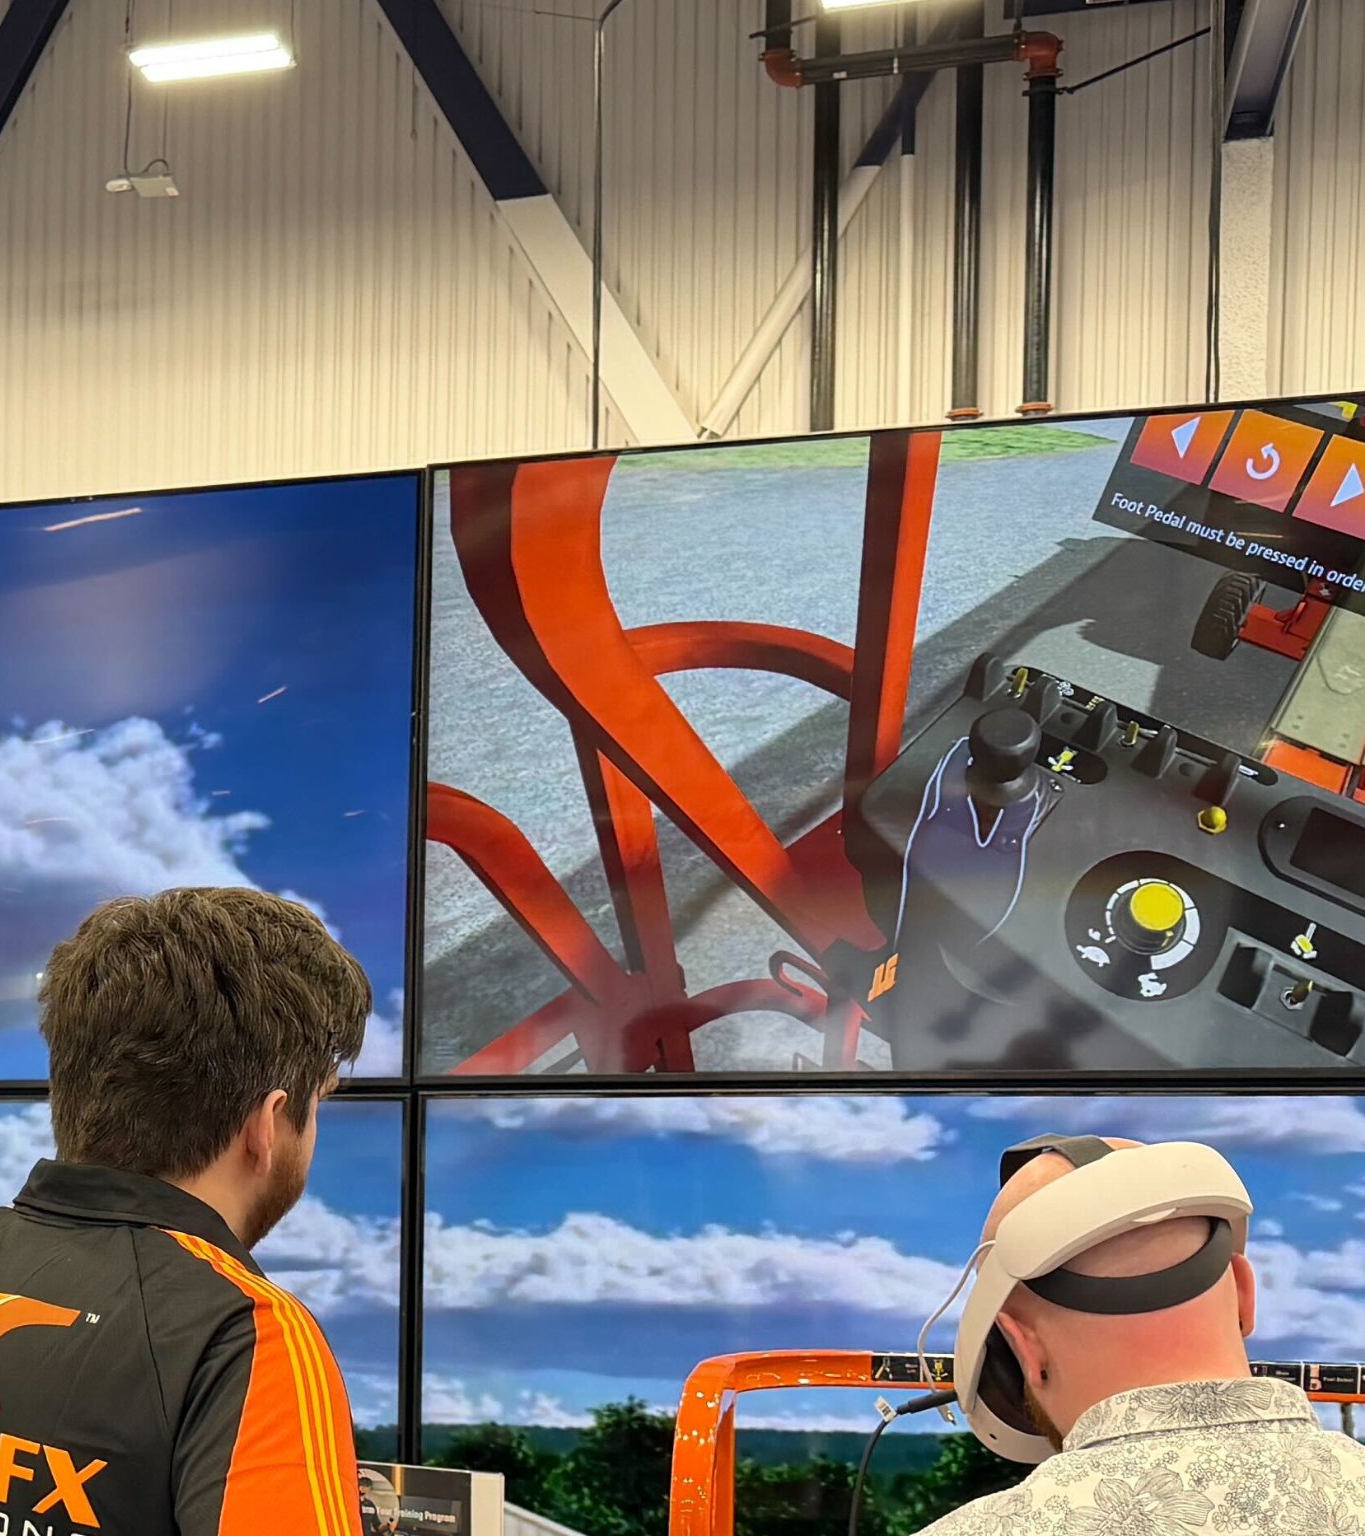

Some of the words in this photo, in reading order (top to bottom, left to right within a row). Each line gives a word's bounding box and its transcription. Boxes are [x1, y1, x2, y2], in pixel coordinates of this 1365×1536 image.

[1111, 492, 1144, 515] Foot
[1145, 505, 1186, 529] Pedal
[1186, 519, 1224, 544] must
[1225, 531, 1245, 550] be
[1245, 542, 1308, 572] pressed
[1308, 560, 1324, 577] in
[424, 1511, 456, 1523] Program
